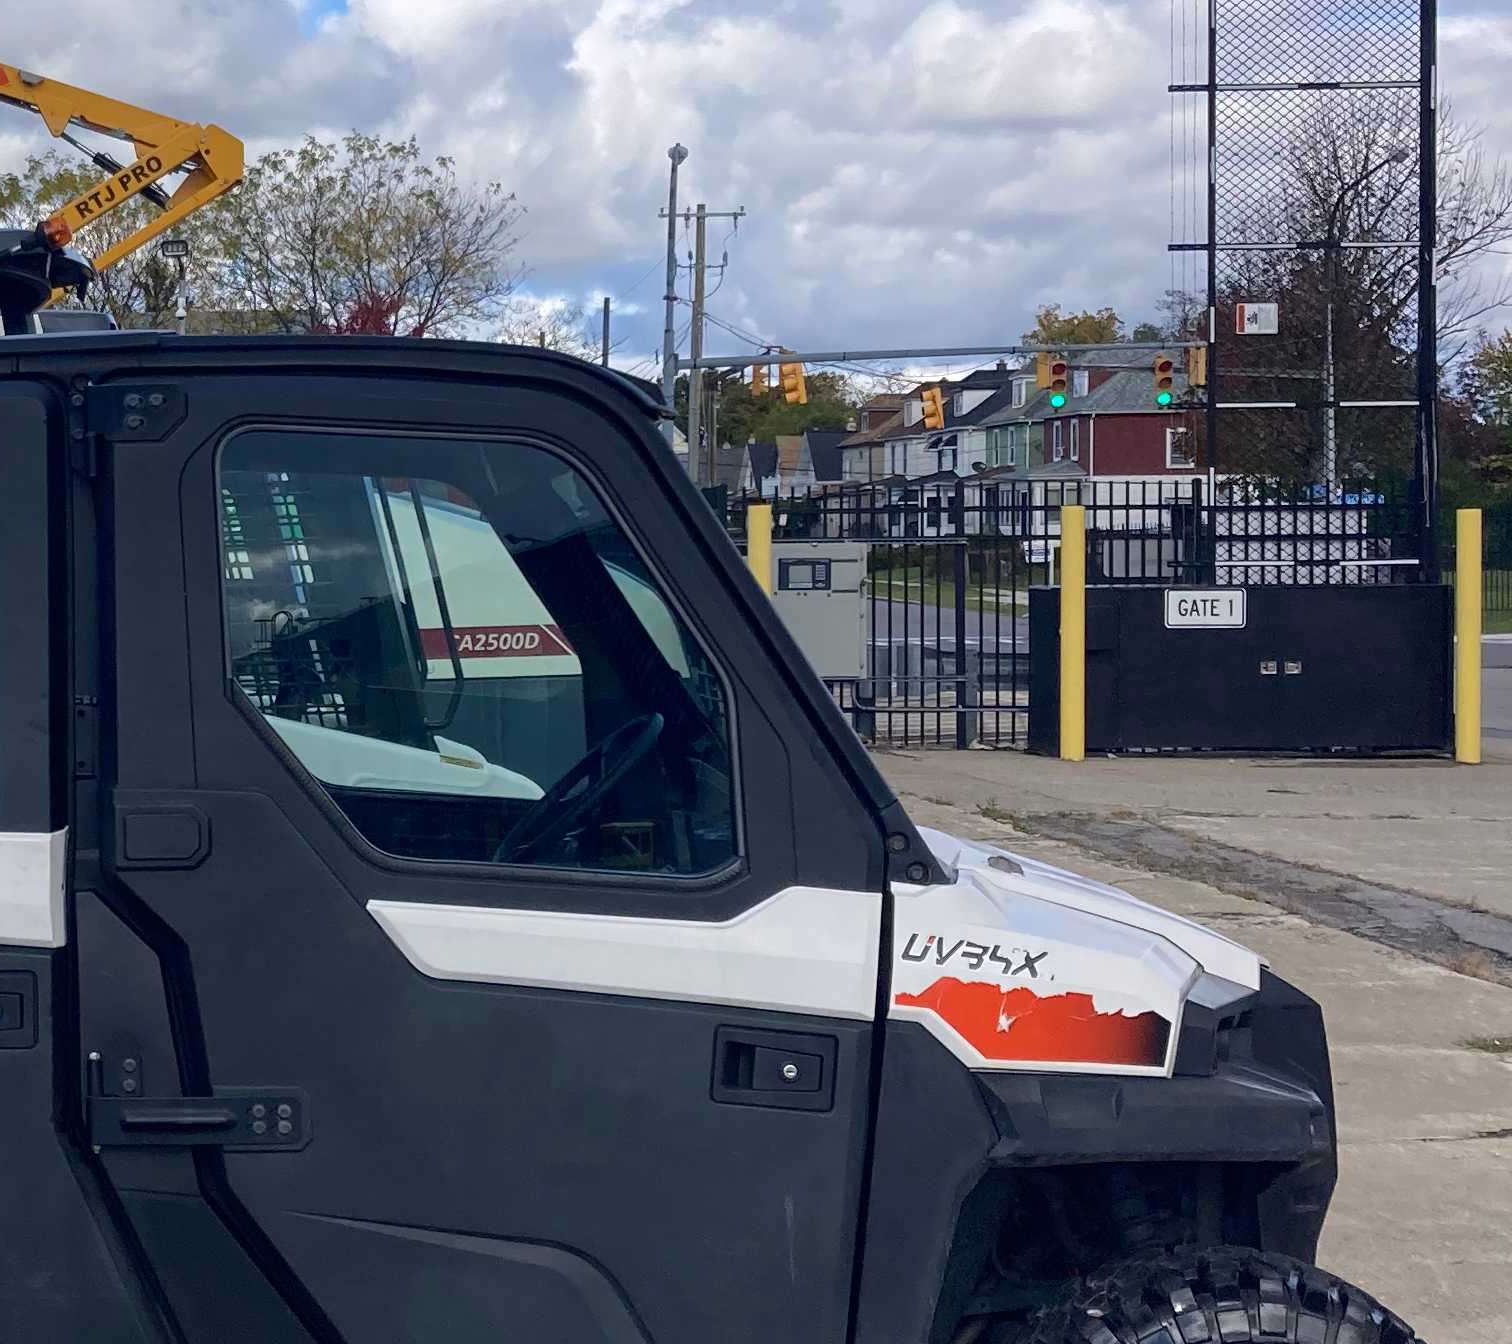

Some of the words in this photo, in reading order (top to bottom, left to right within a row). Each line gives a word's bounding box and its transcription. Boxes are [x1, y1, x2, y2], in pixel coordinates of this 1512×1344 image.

[74, 185, 116, 218] RTJ
[118, 156, 162, 192] PRO
[1178, 599, 1220, 617] GATE
[1228, 599, 1233, 617] 1
[453, 632, 539, 652] A2500D
